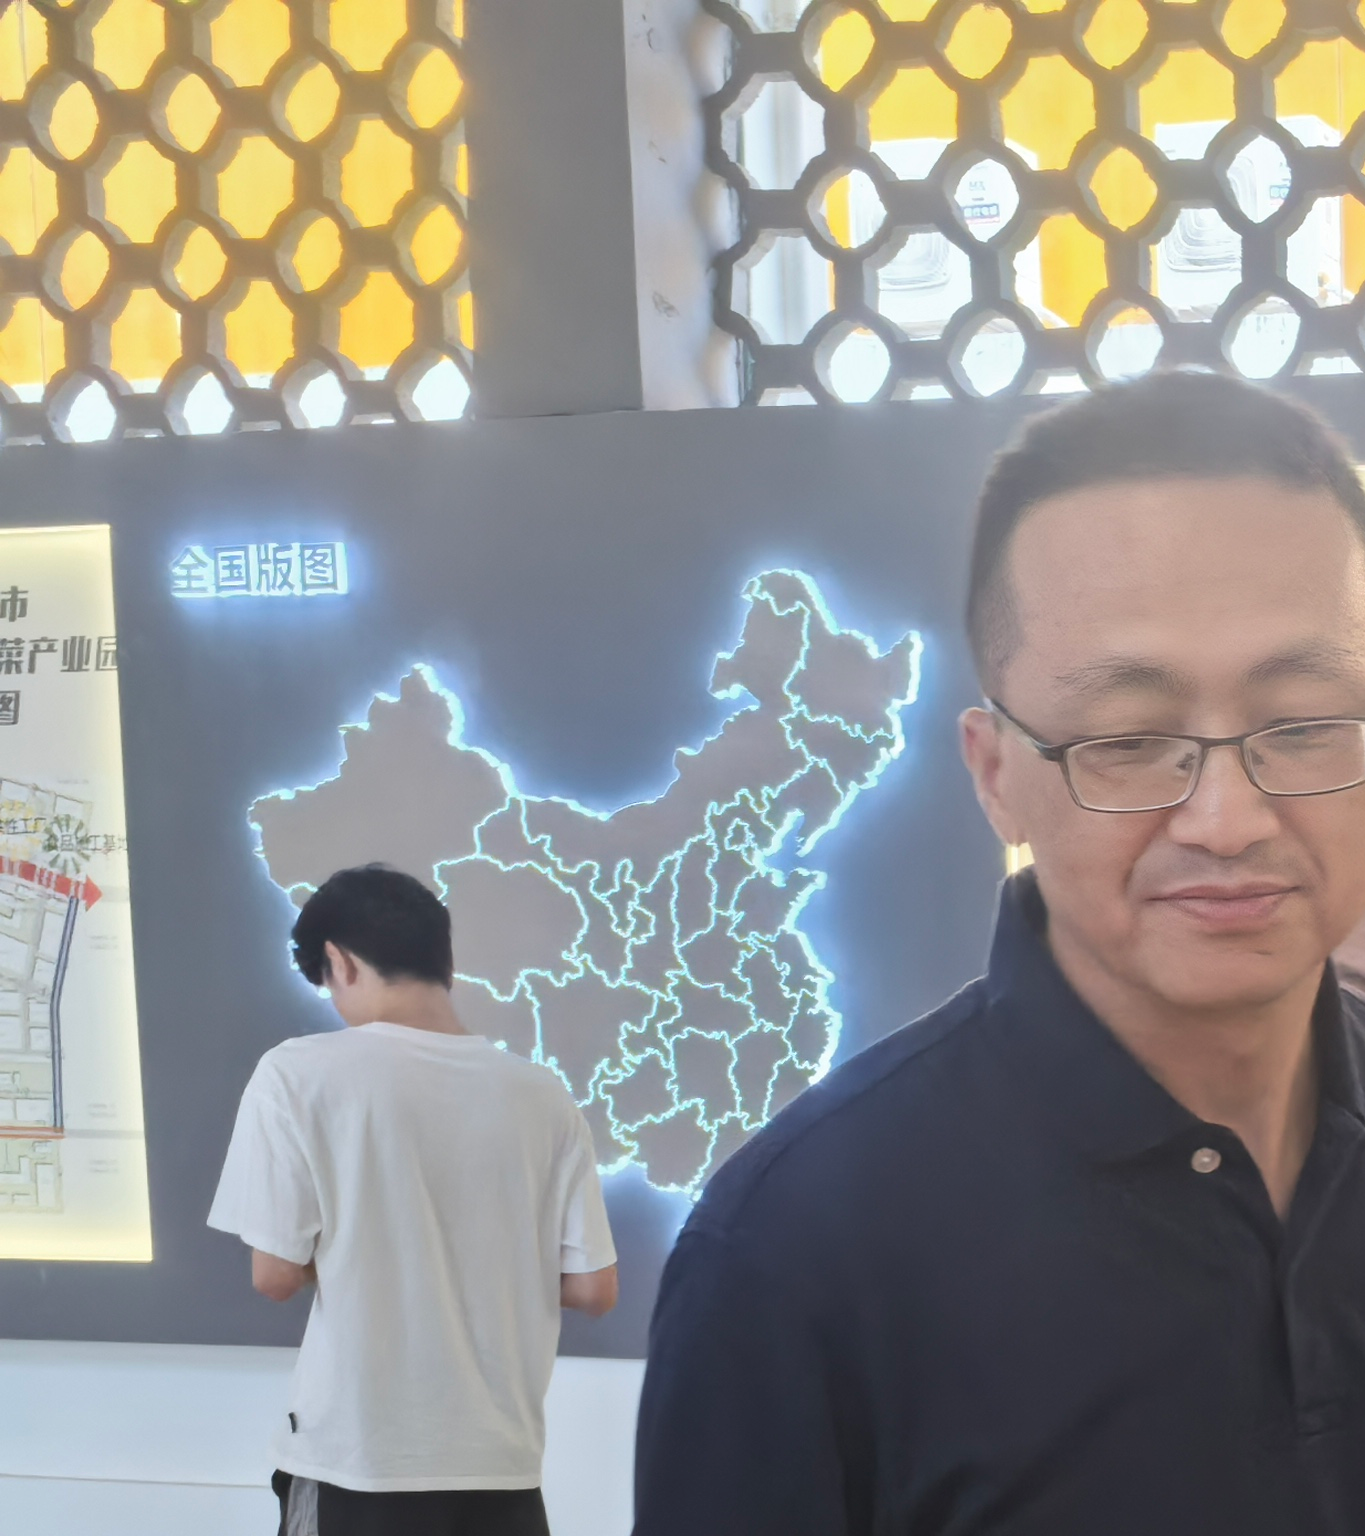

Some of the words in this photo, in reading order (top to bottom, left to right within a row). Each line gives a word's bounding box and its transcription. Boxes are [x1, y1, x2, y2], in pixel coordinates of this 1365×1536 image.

[170, 543, 341, 594] 全国版图
[0, 586, 29, 622] 市
